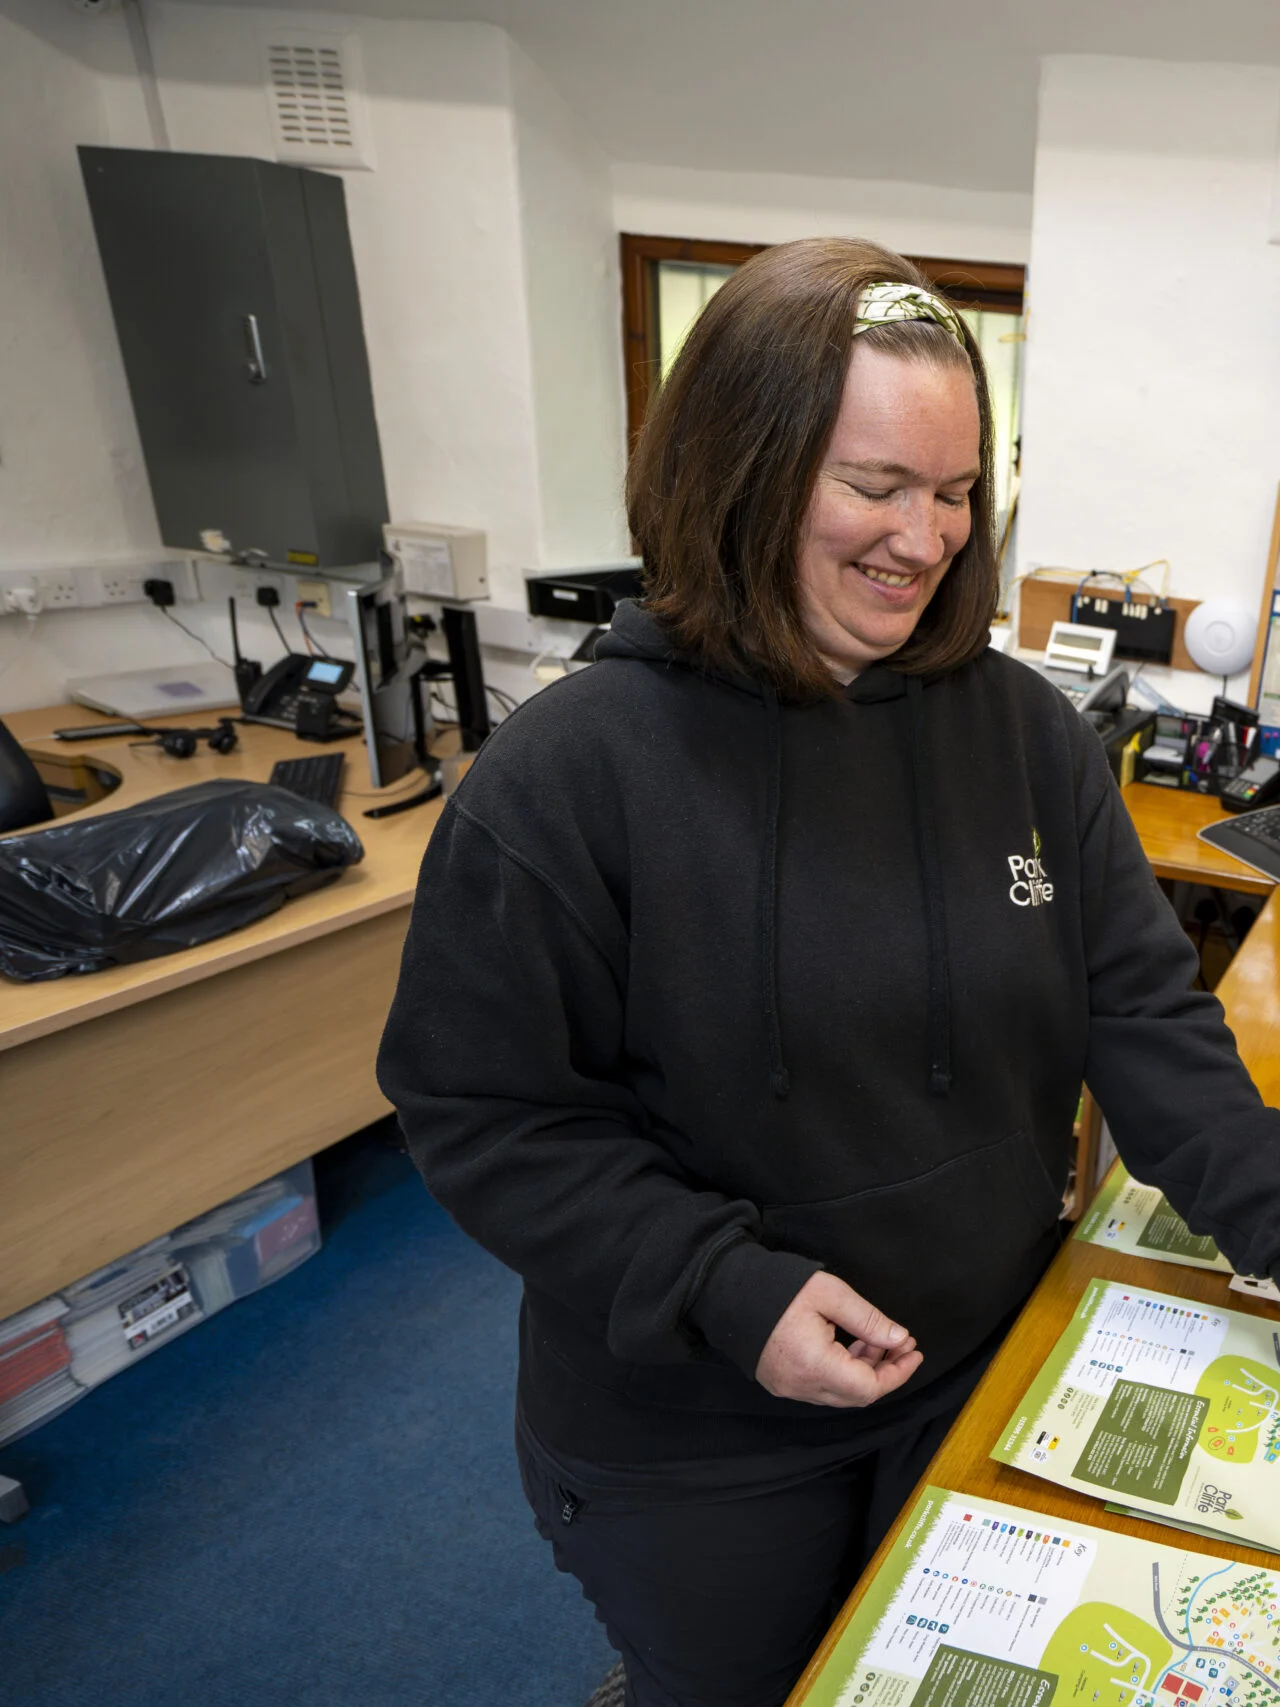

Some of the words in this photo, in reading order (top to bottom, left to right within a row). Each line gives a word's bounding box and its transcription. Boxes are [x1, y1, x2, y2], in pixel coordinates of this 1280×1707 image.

[1008, 855, 1048, 881] Pak
[1188, 1400, 1206, 1432] Essential
[1178, 1430, 1194, 1460] Information
[1197, 1484, 1218, 1513] Cliffe
[1213, 1490, 1232, 1514] Park
[904, 1500, 934, 1549] parkcliffe.co.uk
[1074, 1543, 1087, 1557] Key
[1032, 1678, 1051, 1707] Essen
